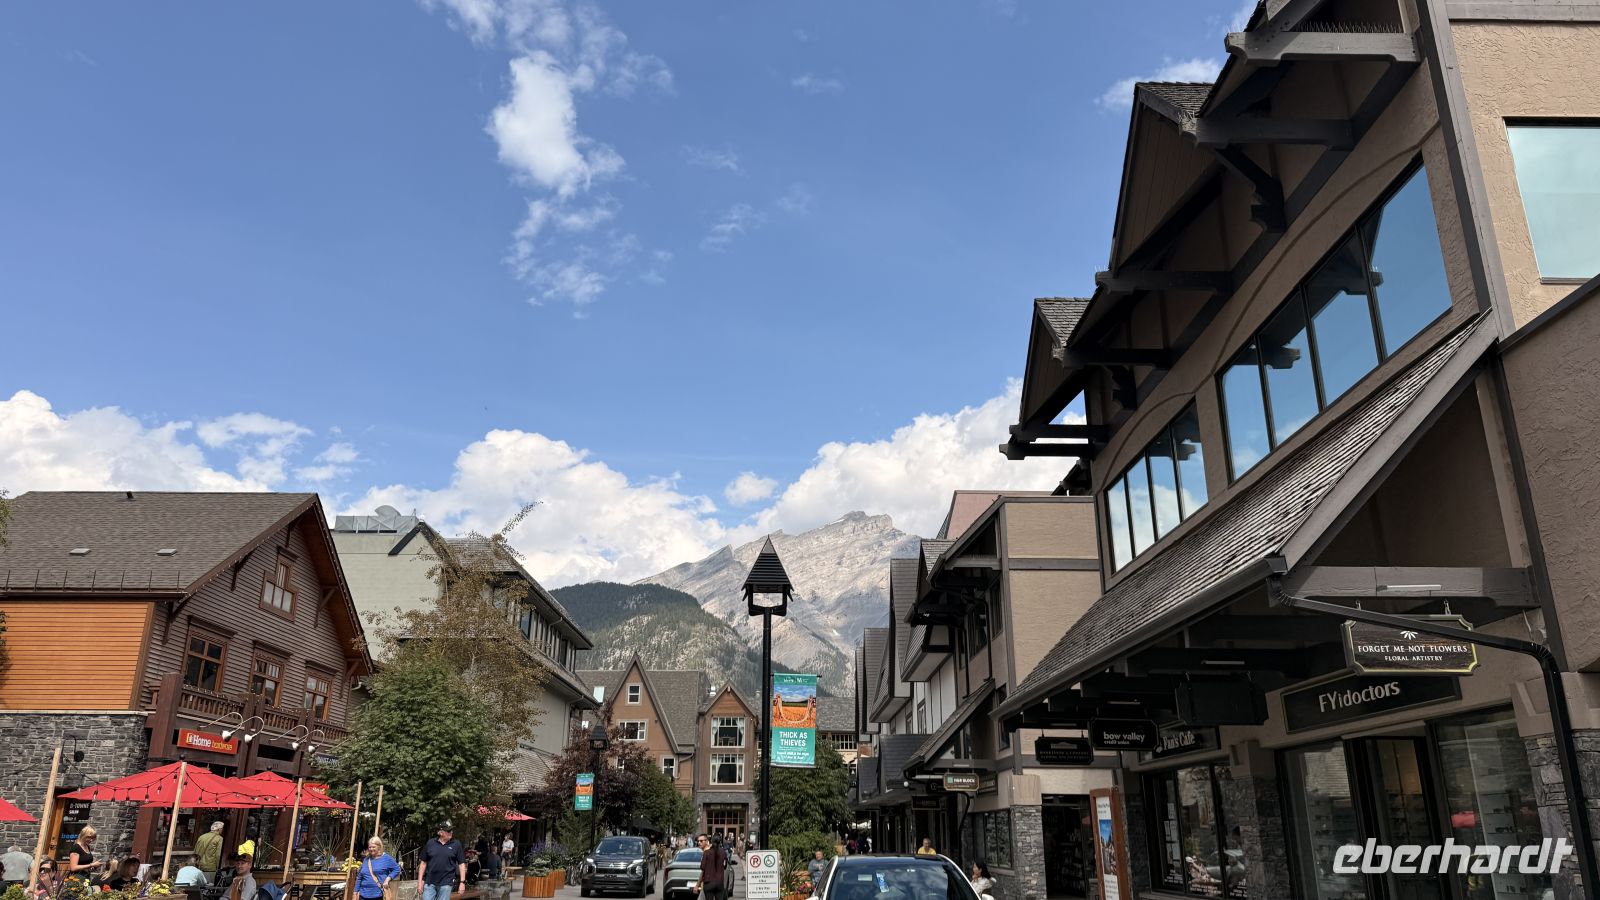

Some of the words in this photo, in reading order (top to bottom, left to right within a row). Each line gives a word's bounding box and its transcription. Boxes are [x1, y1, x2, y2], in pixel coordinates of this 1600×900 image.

[1357, 645, 1390, 653] FORGET
[1430, 645, 1468, 653] FLOWERS
[1318, 681, 1401, 713] FYidoctors
[779, 731, 798, 740] THICK
[799, 732, 808, 740] AS
[1103, 731, 1121, 740] bow
[1122, 732, 1145, 744] valley
[193, 735, 212, 748] Home
[780, 739, 806, 747] THIEVES
